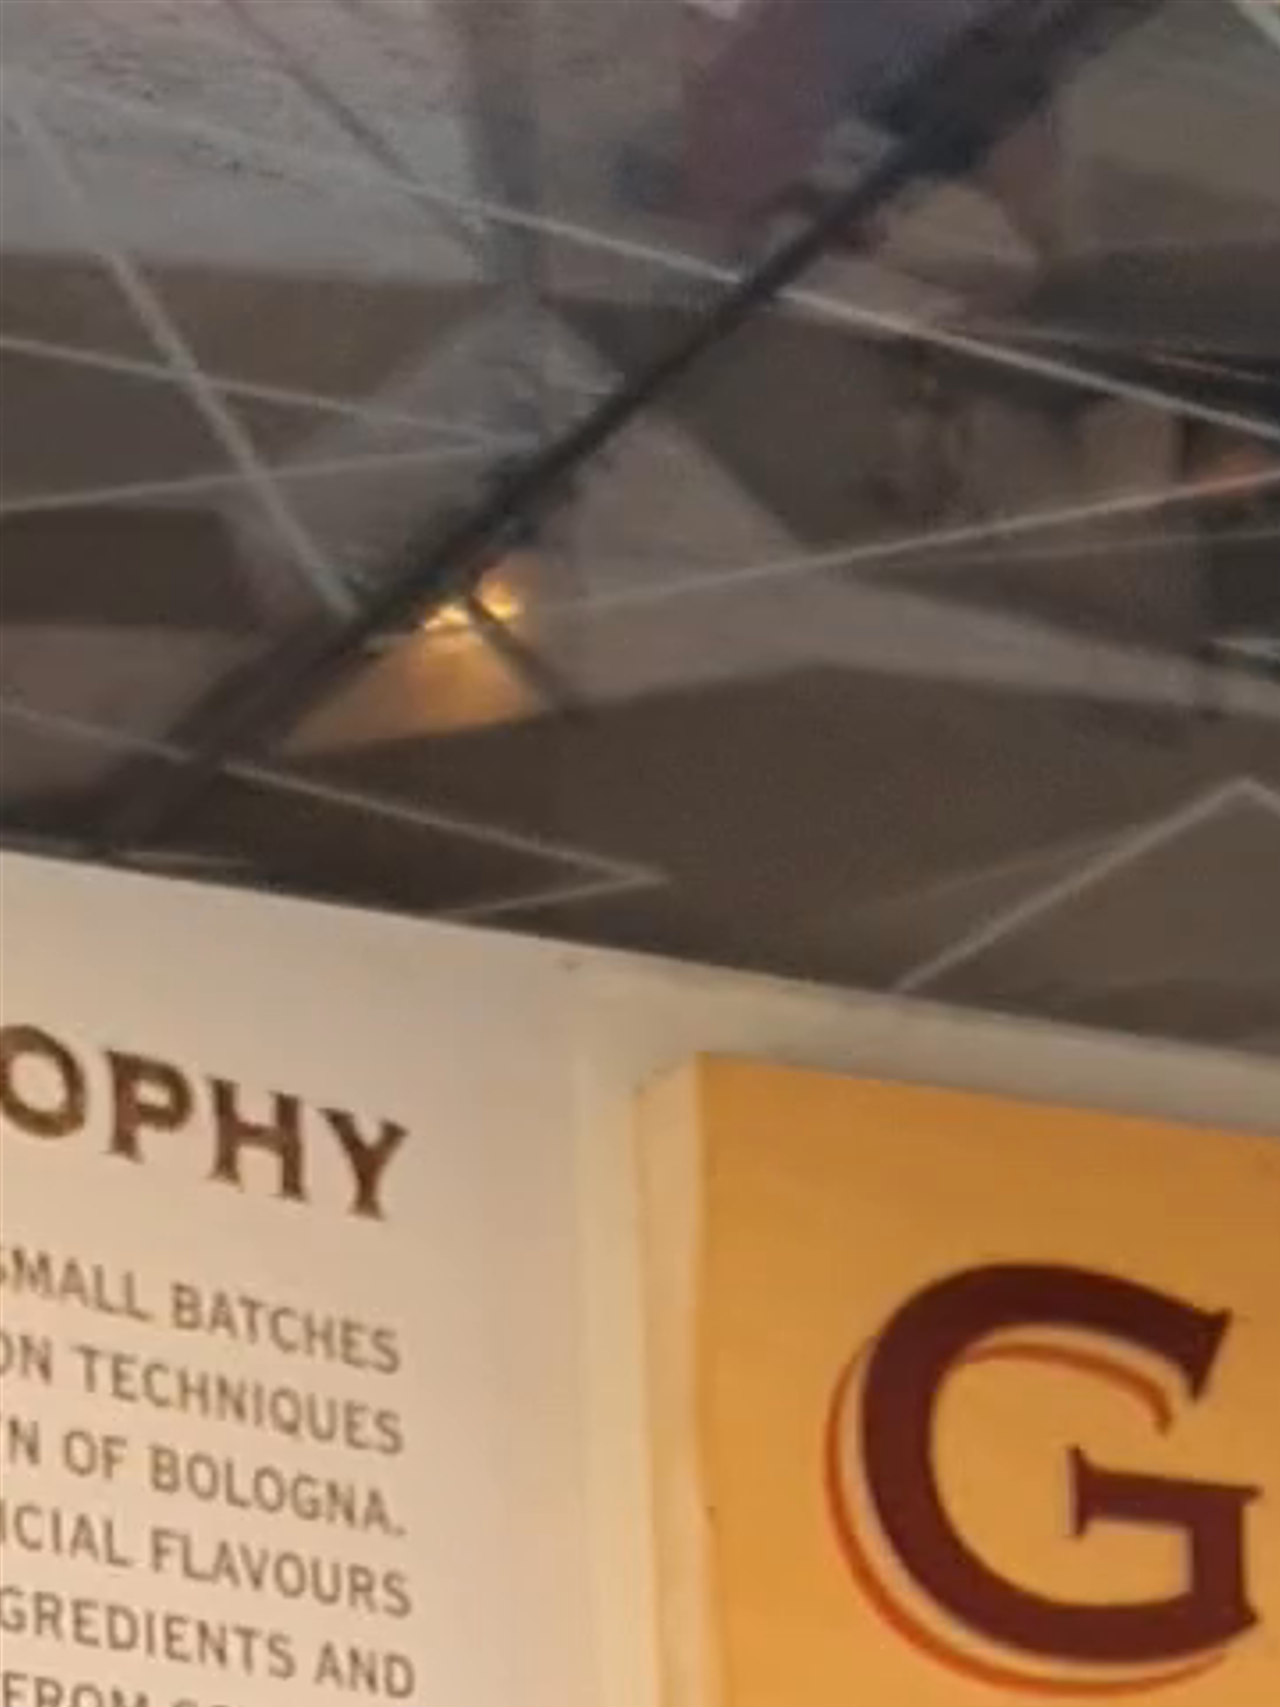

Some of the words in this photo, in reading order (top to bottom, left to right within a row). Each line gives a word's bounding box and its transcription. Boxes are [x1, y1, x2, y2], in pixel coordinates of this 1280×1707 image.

[0, 1024, 410, 1222] OPHY
[171, 1281, 402, 1375] BATCHES
[72, 1342, 404, 1456] TECHNIQUES
[62, 1430, 127, 1481] OF
[149, 1444, 406, 1536] BOLOGNA.
[151, 1527, 413, 1619] FLAVOURS
[0, 1585, 297, 1682] GREDIENTS
[313, 1642, 416, 1699] AND
